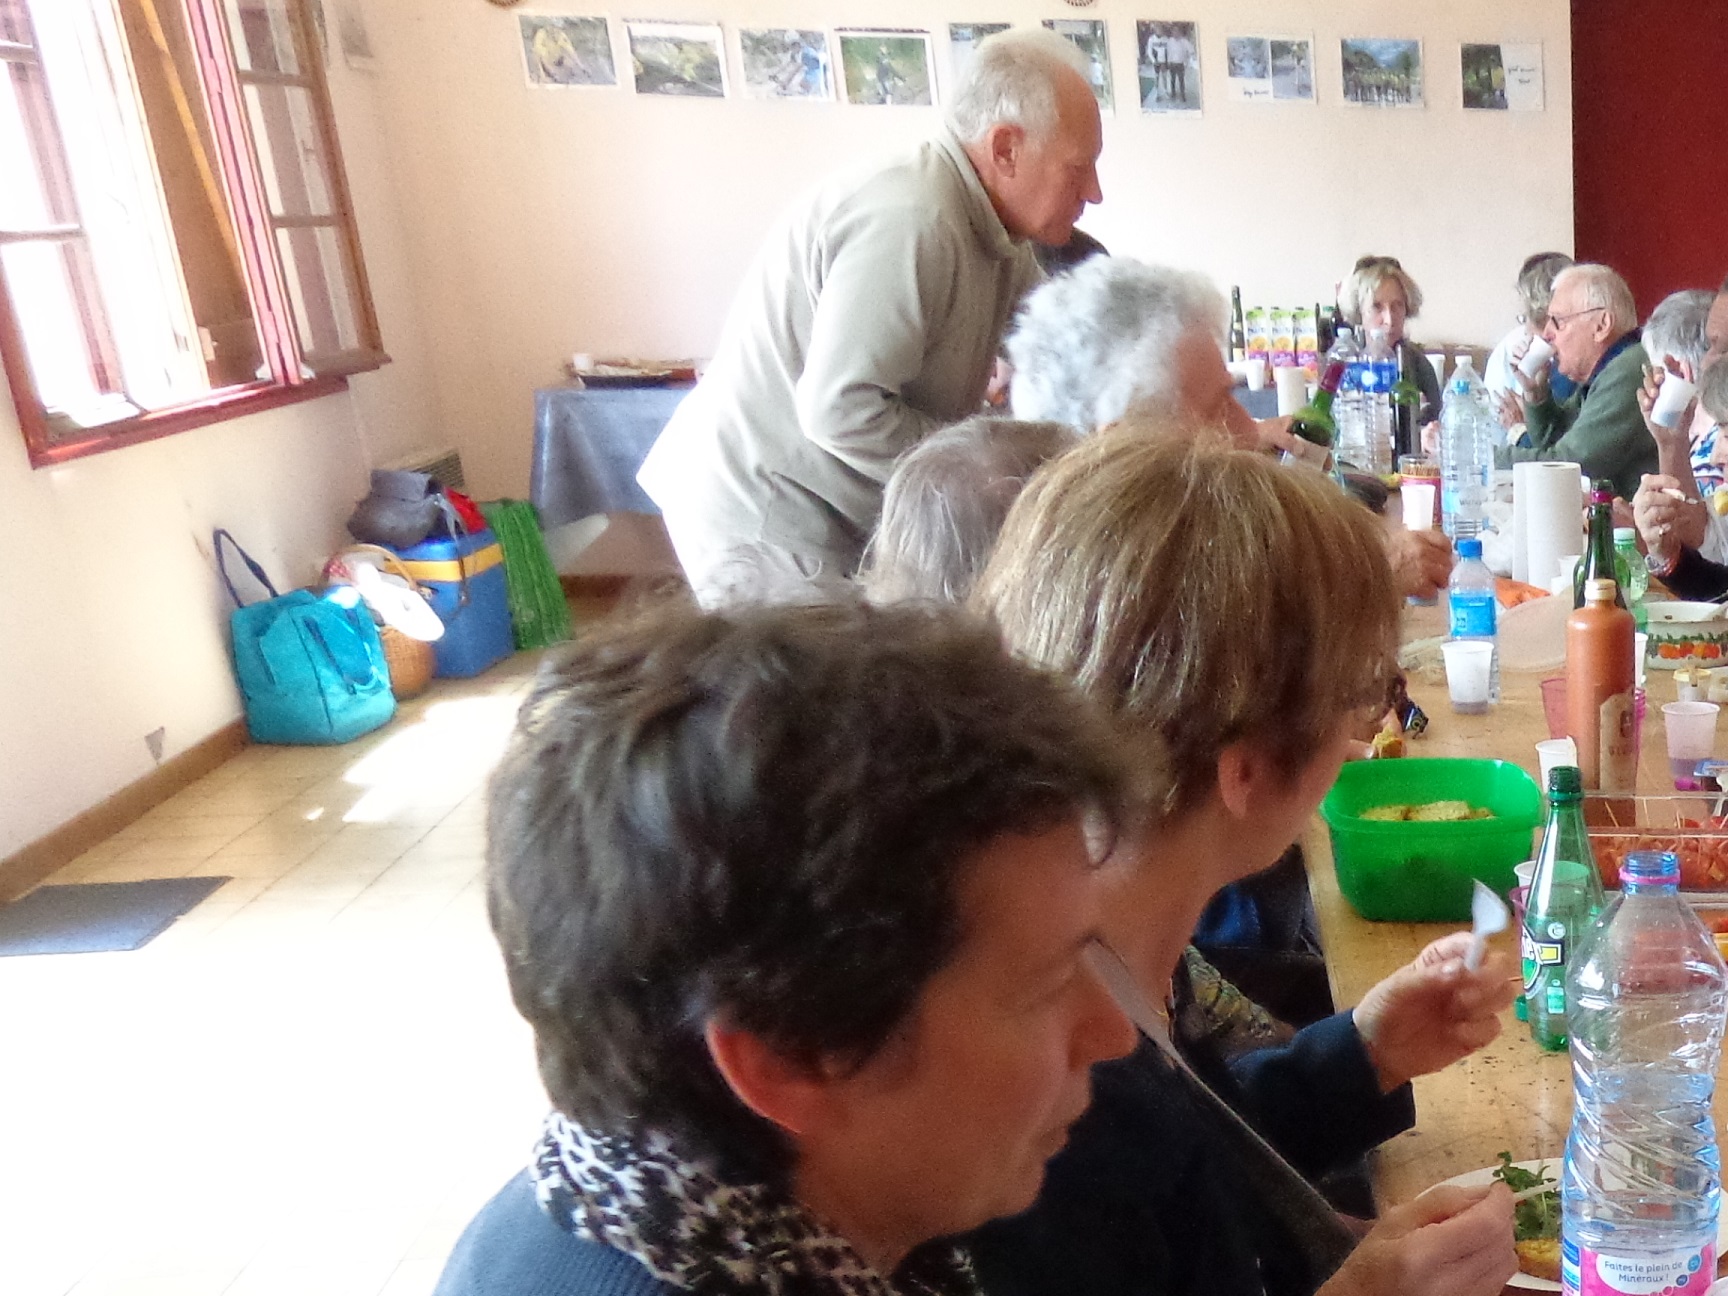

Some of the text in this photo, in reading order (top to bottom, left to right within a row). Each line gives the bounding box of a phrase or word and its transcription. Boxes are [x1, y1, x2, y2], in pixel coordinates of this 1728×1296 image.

[1604, 1260, 1633, 1273] Faites
[1635, 1263, 1644, 1273] le
[1646, 1262, 1670, 1274] plein
[1672, 1261, 1683, 1270] de
